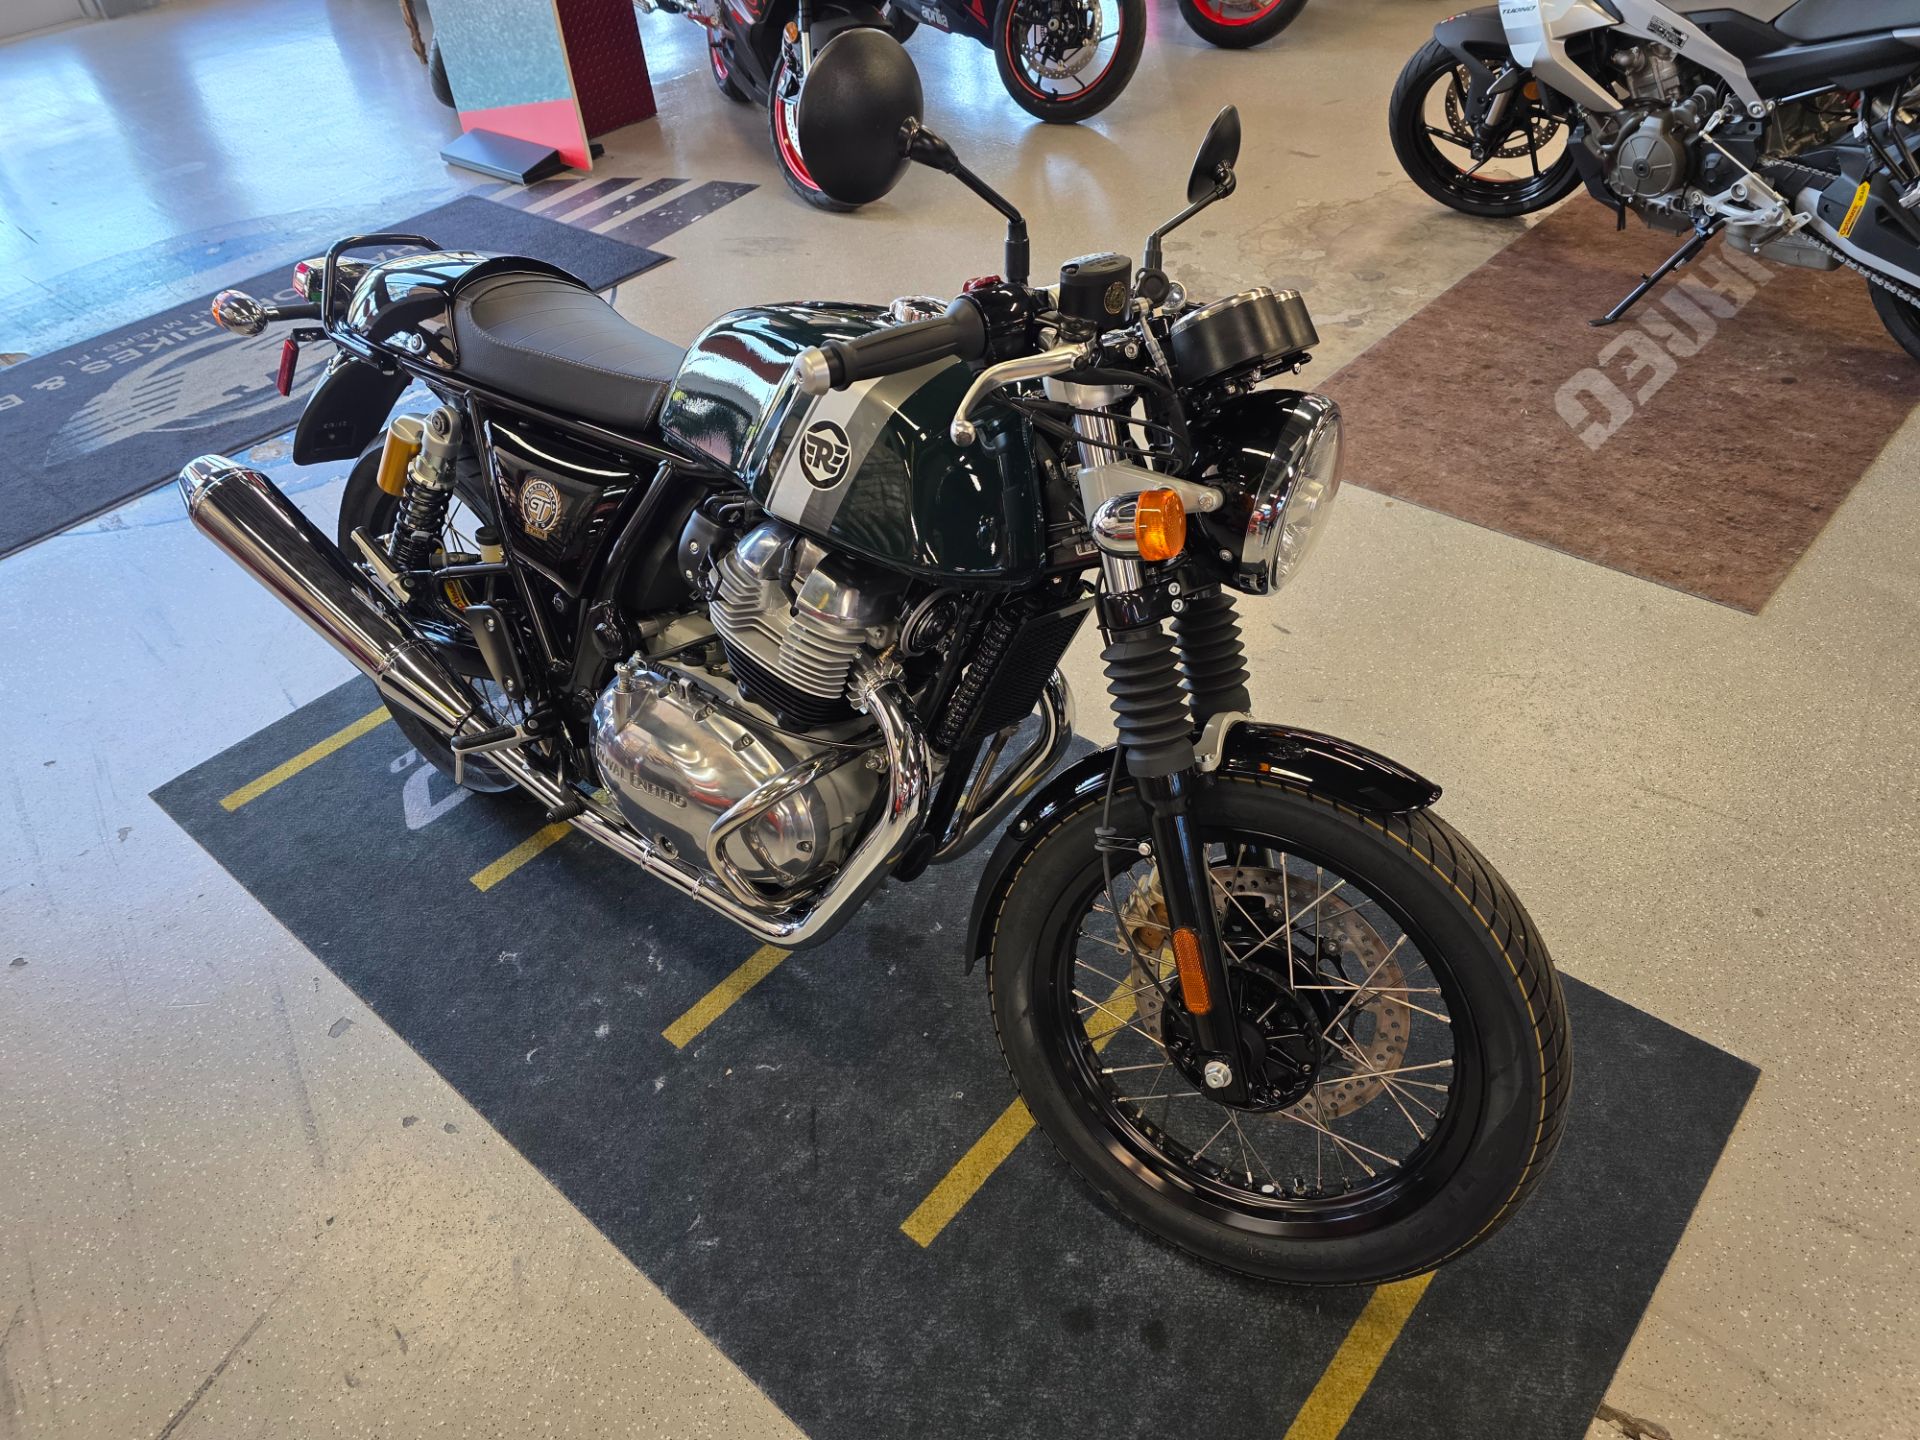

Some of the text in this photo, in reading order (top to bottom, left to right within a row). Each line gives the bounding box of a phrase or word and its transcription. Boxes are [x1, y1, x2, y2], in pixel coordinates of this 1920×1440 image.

[920, 5, 950, 29] aprilia
[31, 320, 217, 391] RIKES &
[1554, 242, 1777, 451] AREG
[529, 494, 551, 521] GT
[629, 772, 688, 809] ENFIELD
